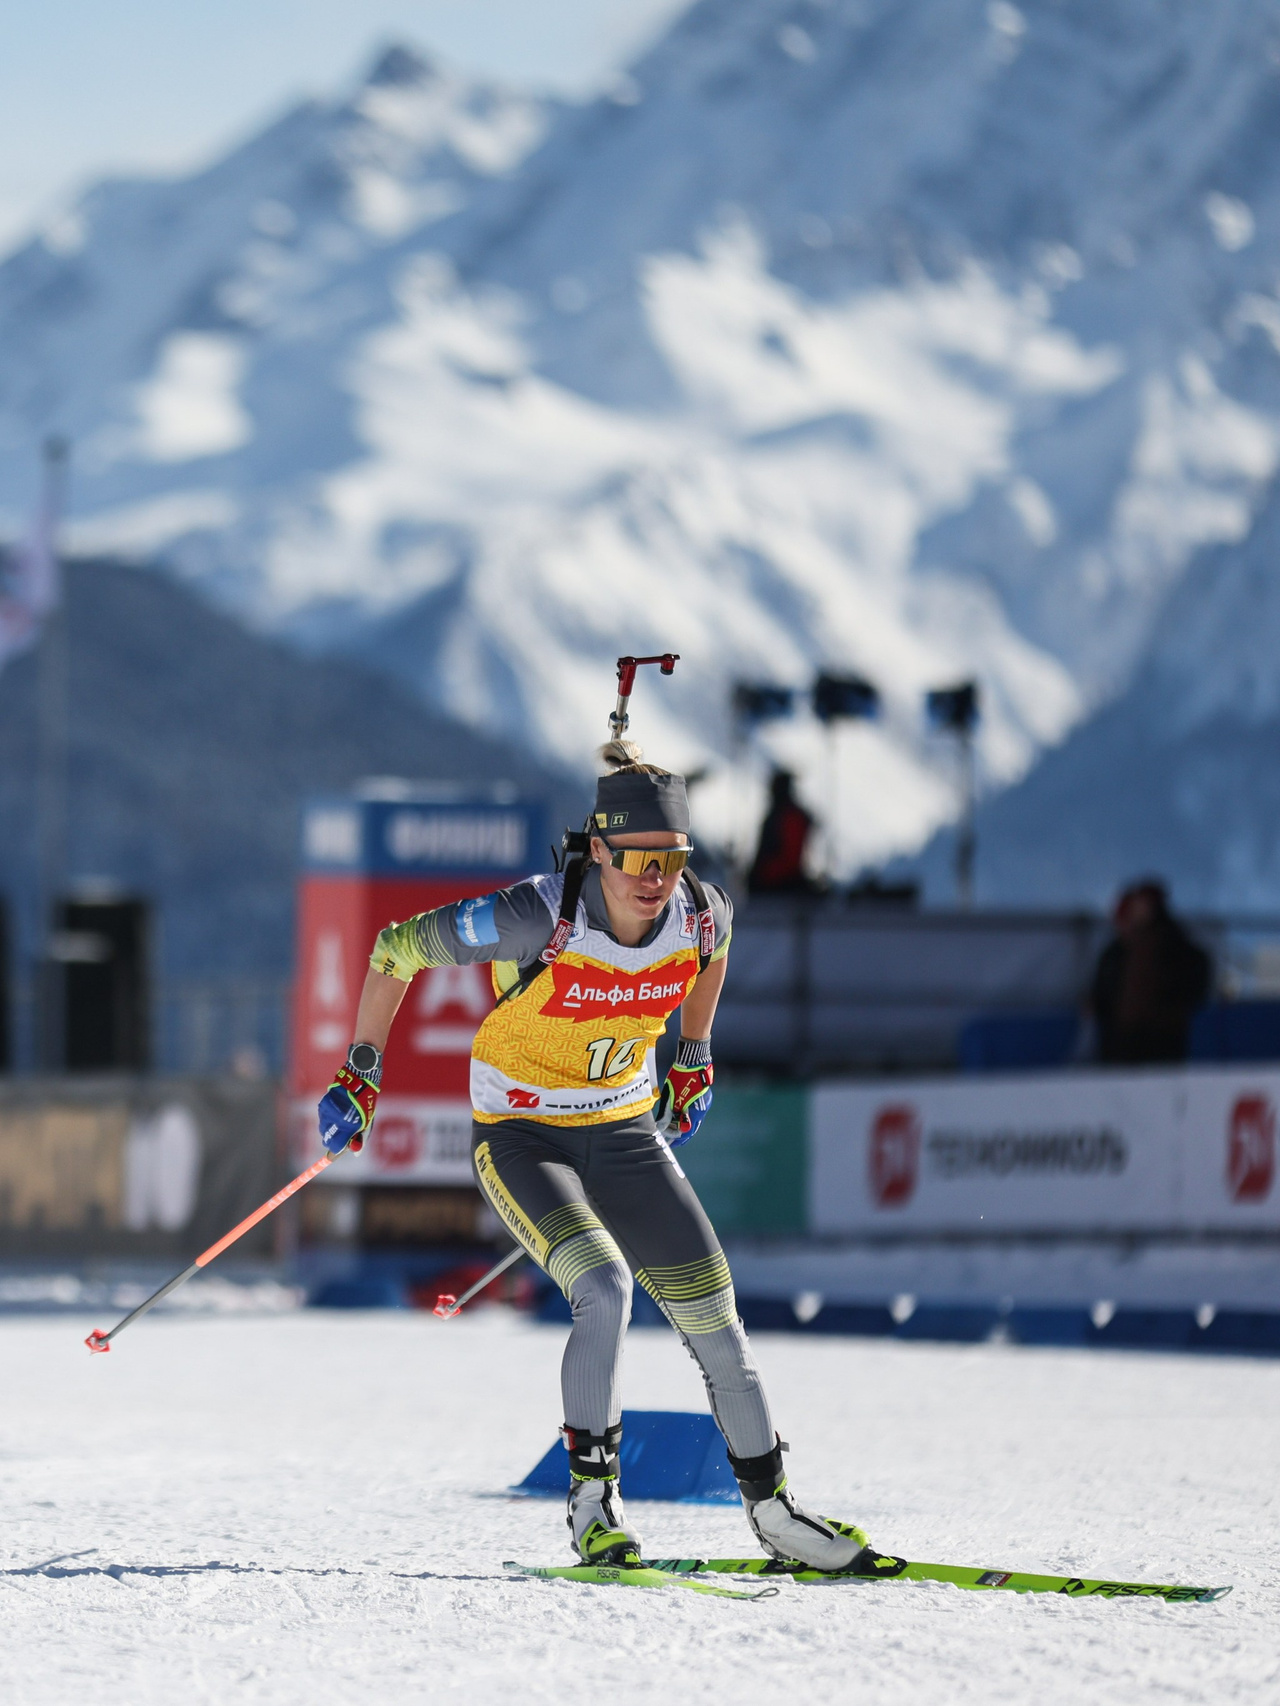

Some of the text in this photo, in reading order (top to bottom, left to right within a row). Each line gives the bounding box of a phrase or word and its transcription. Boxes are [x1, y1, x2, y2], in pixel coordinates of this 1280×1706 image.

[564, 981, 684, 1006] Альфа Банк
[597, 1568, 621, 1580] FISCHER
[1090, 1583, 1209, 1601] FISCHER
